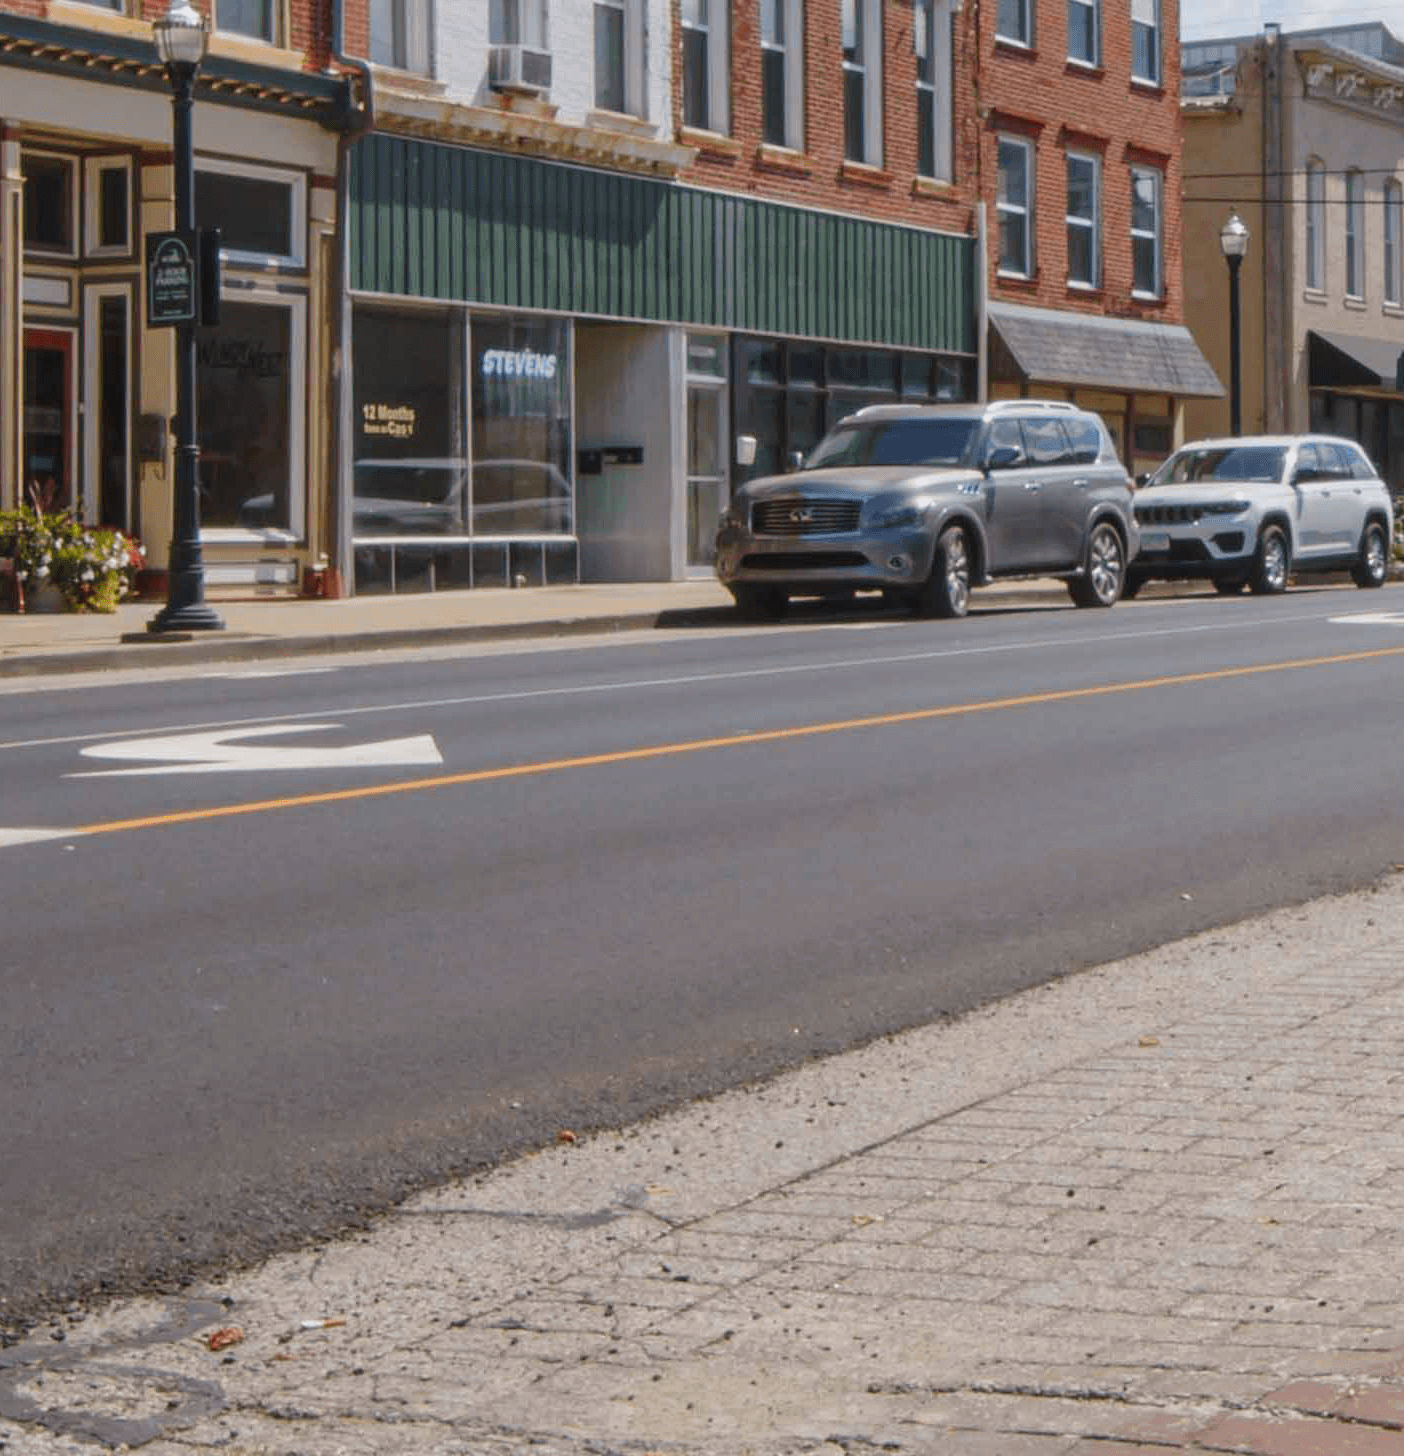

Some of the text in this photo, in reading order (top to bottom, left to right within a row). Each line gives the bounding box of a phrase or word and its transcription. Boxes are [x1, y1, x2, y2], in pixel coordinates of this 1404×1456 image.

[482, 349, 557, 379] STEVENS
[363, 403, 415, 421] 12 Months
